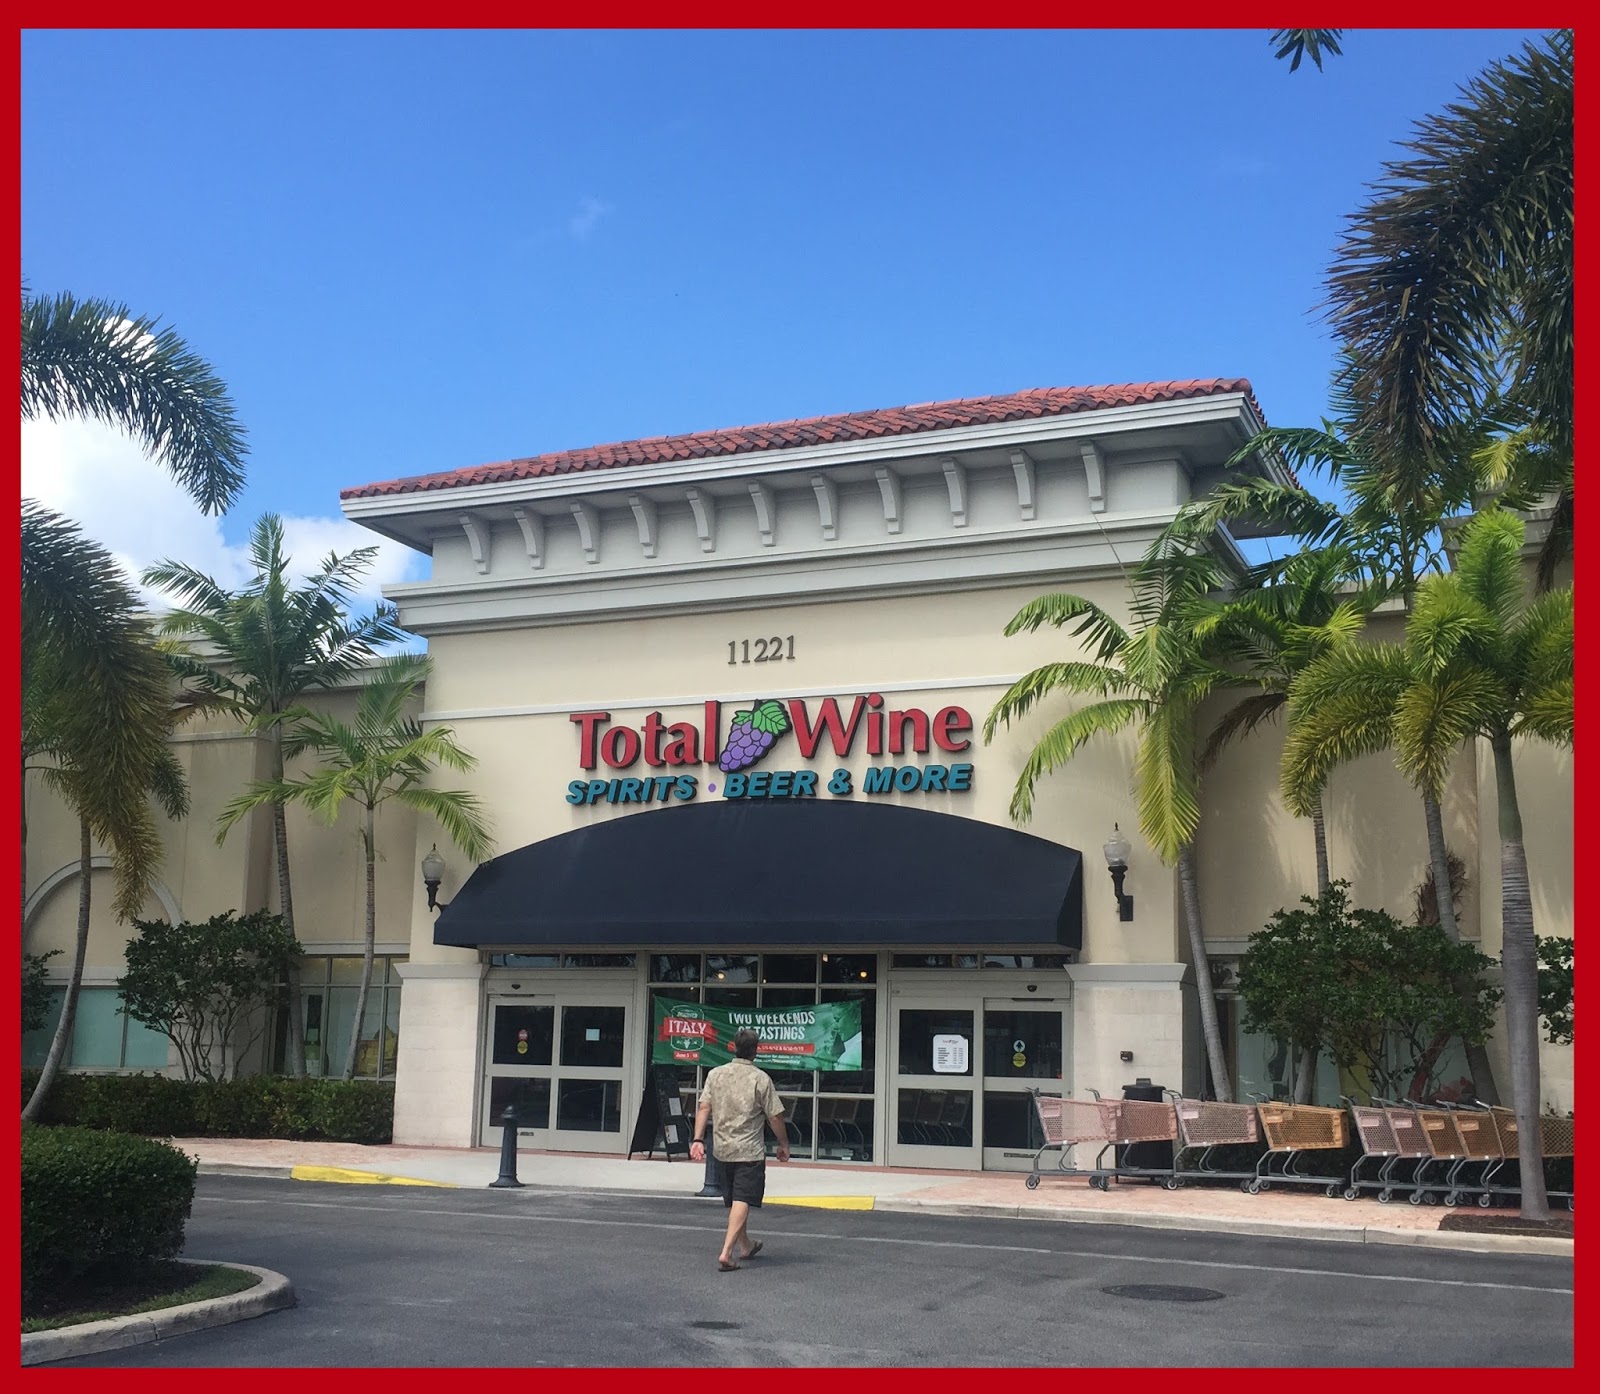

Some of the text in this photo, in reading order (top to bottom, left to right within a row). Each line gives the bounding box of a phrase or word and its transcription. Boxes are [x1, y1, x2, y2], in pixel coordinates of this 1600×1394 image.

[727, 635, 796, 665] 11221
[568, 693, 973, 770] Total Wine
[566, 763, 974, 805] SPIRITS BEER & MORE
[668, 1020, 707, 1034] ITALY
[755, 1011, 816, 1025] WEEKENDS
[754, 1026, 806, 1040] TASTINGS
